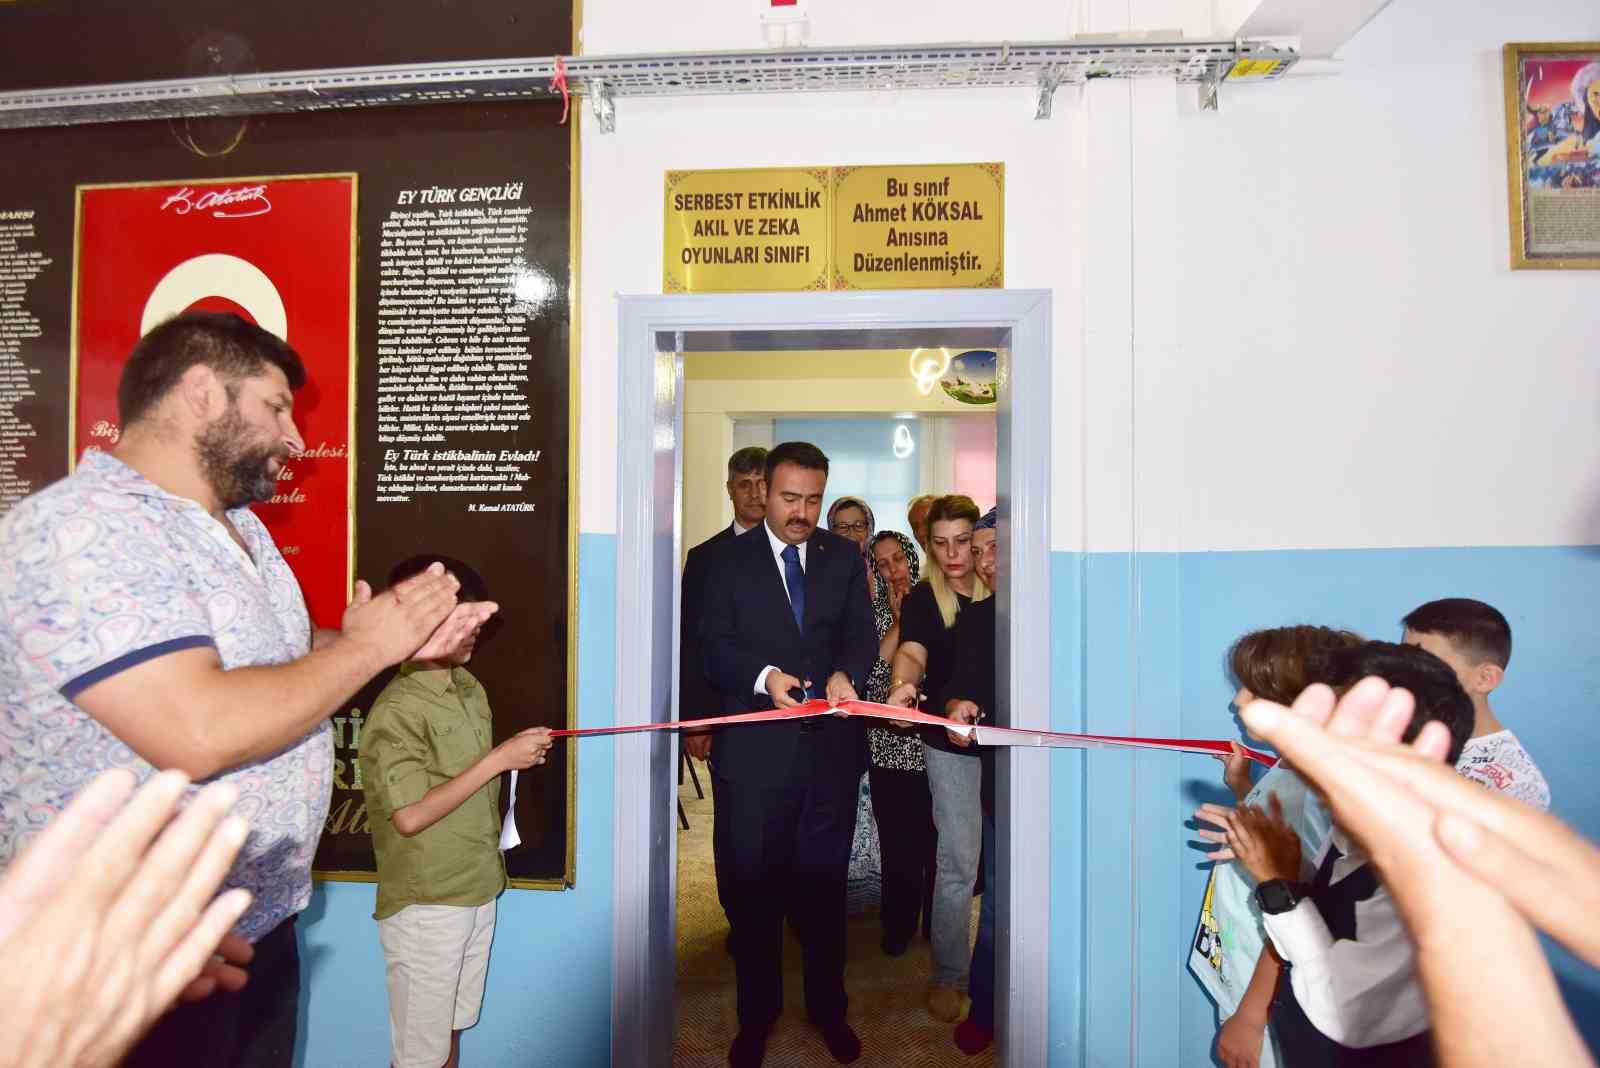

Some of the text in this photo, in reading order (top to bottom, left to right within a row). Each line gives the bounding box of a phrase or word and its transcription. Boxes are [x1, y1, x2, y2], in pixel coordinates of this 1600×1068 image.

[397, 182, 523, 205] EY TÜRK GENÇLİĞİ
[887, 177, 949, 197] Bu sınıf
[674, 187, 820, 211] SERBEST ETKİNLİK
[853, 198, 983, 222] Ahmet KÖKSAL
[694, 218, 800, 237] AKIL VE ZEKA
[887, 228, 948, 247] Anısına
[682, 245, 810, 265] OYUNLARI SINIFI
[853, 250, 982, 275] Düzenlenmiştir.
[385, 450, 540, 462] Ey Türk istikbalinin Evladı!
